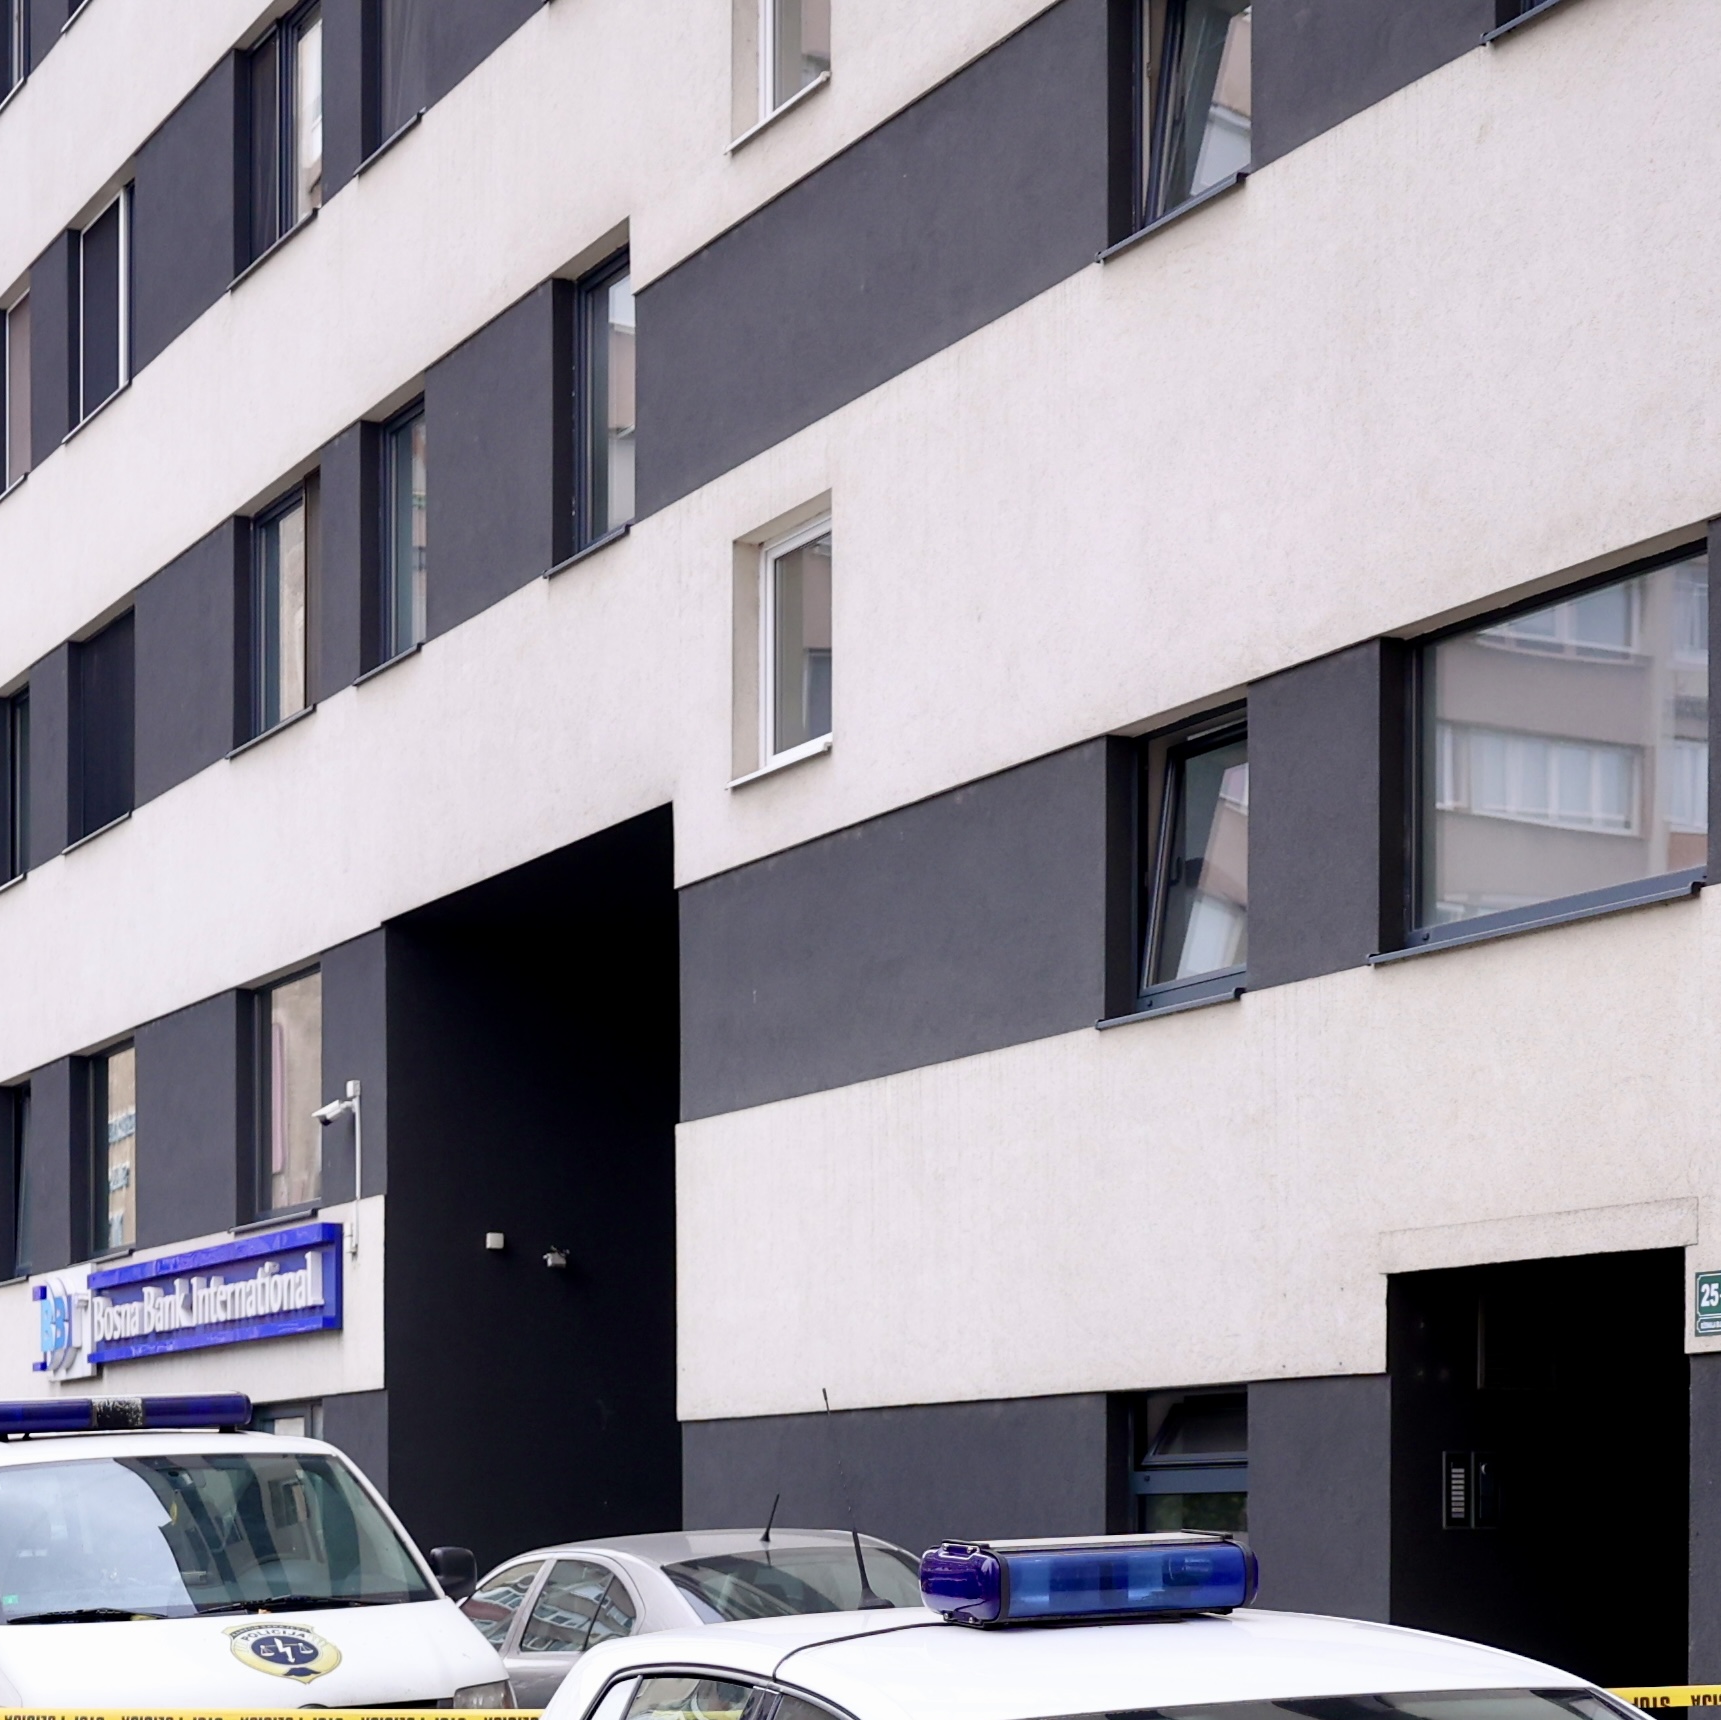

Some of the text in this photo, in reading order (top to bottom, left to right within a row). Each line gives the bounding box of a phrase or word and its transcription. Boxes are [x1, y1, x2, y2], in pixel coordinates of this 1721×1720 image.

[91, 1252, 322, 1342] Bosna Bank International
[240, 1629, 306, 1641] POLICIJA
